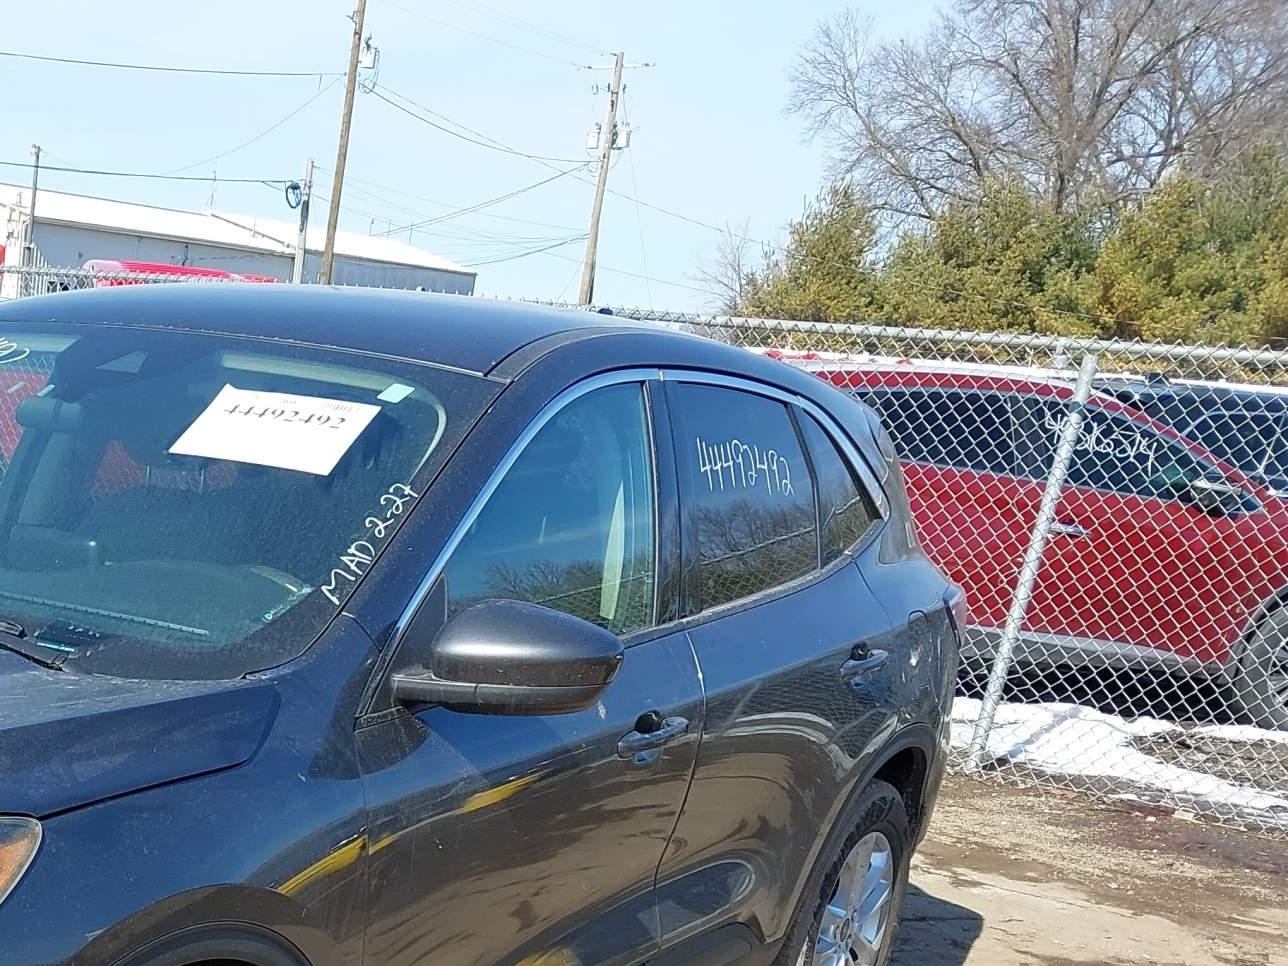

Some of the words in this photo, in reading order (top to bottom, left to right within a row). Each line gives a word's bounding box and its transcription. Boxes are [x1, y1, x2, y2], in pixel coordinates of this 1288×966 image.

[223, 403, 347, 430] 44492492
[696, 436, 795, 497] 44492492
[320, 540, 376, 606] MAD
[365, 483, 419, 538] 2-27
